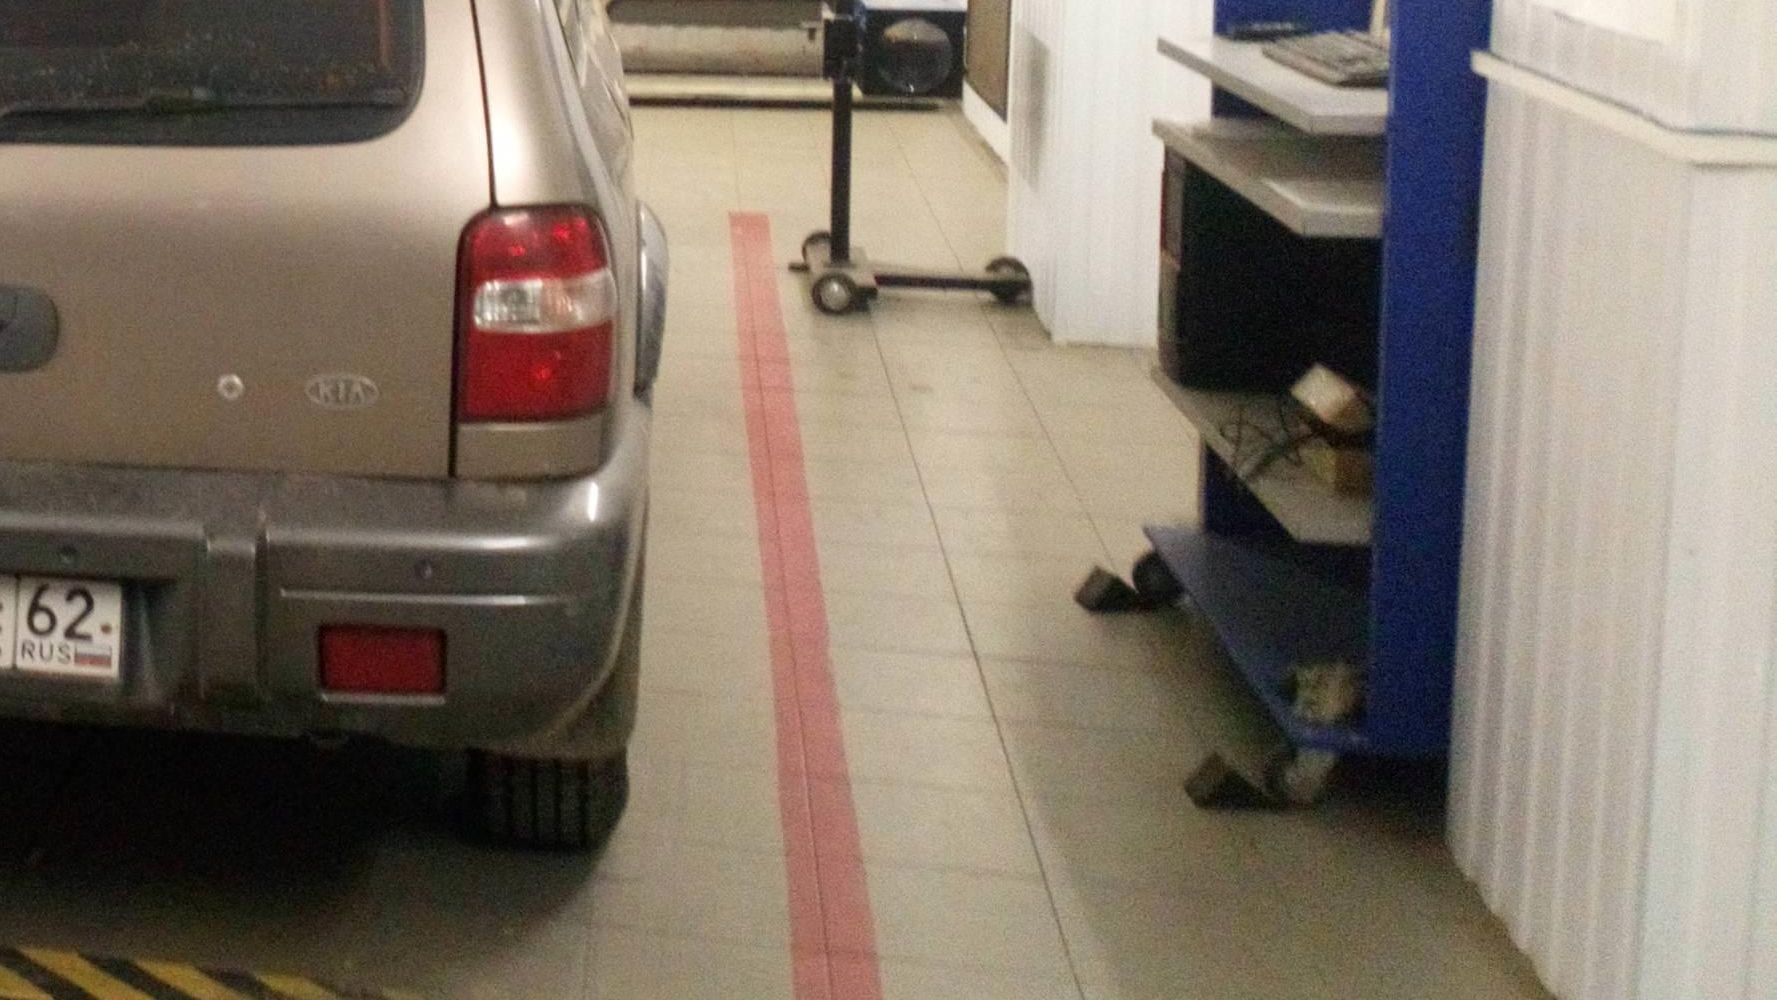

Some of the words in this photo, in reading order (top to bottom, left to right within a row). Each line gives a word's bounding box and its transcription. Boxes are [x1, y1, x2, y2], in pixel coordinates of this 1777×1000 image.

[318, 380, 366, 403] KIA
[26, 583, 96, 642] 62
[21, 642, 71, 665] RUS
